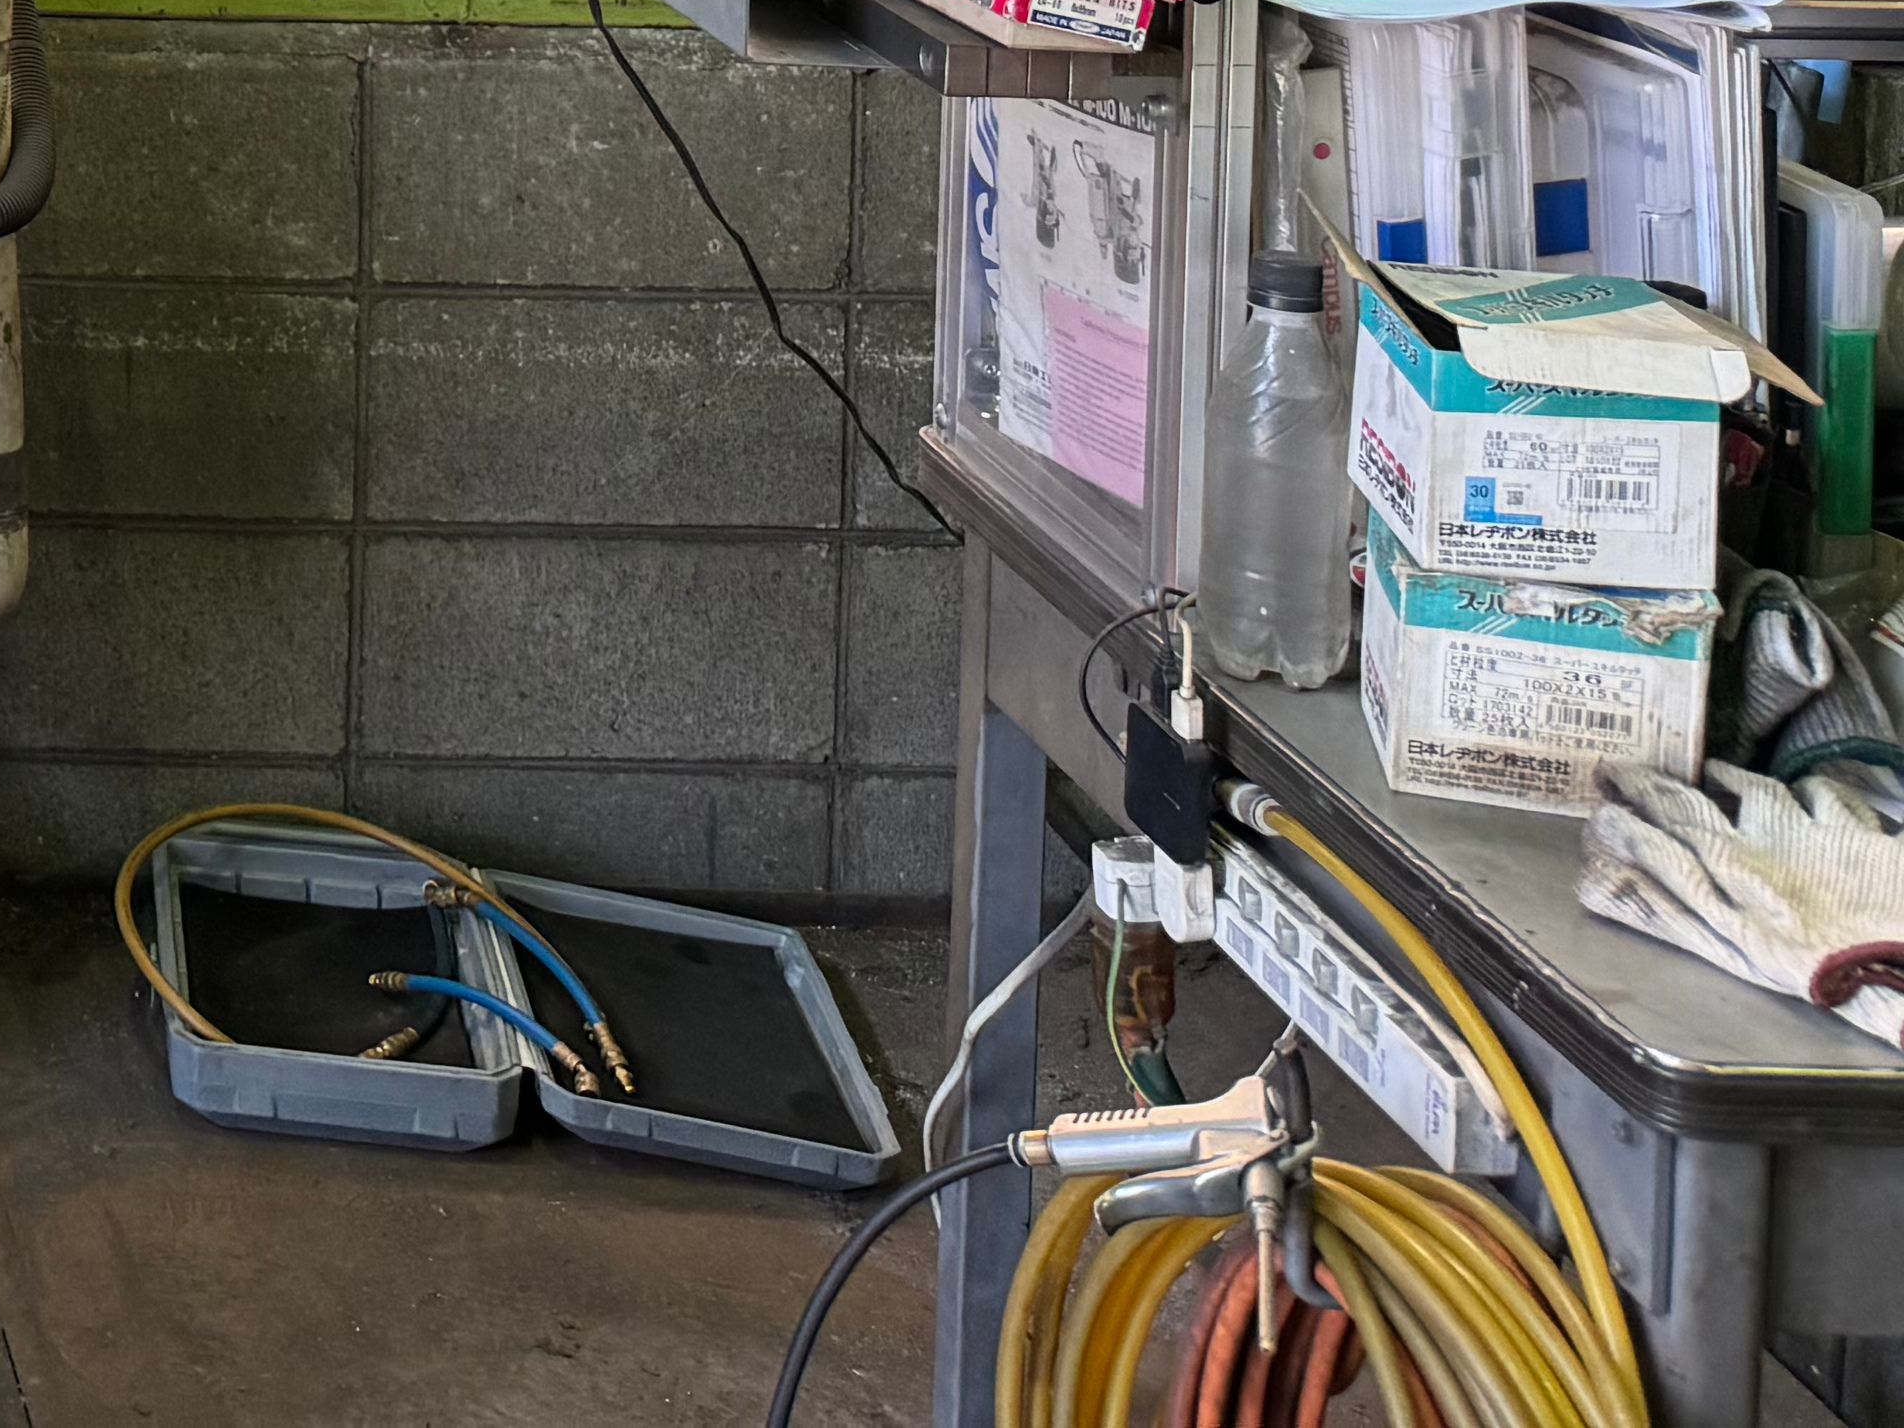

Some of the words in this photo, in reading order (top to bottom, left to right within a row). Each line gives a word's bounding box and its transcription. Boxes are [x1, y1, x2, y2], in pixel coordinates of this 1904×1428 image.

[1470, 484, 1489, 498] 30
[1563, 670, 1603, 686] 36
[1449, 681, 1477, 695] MAX
